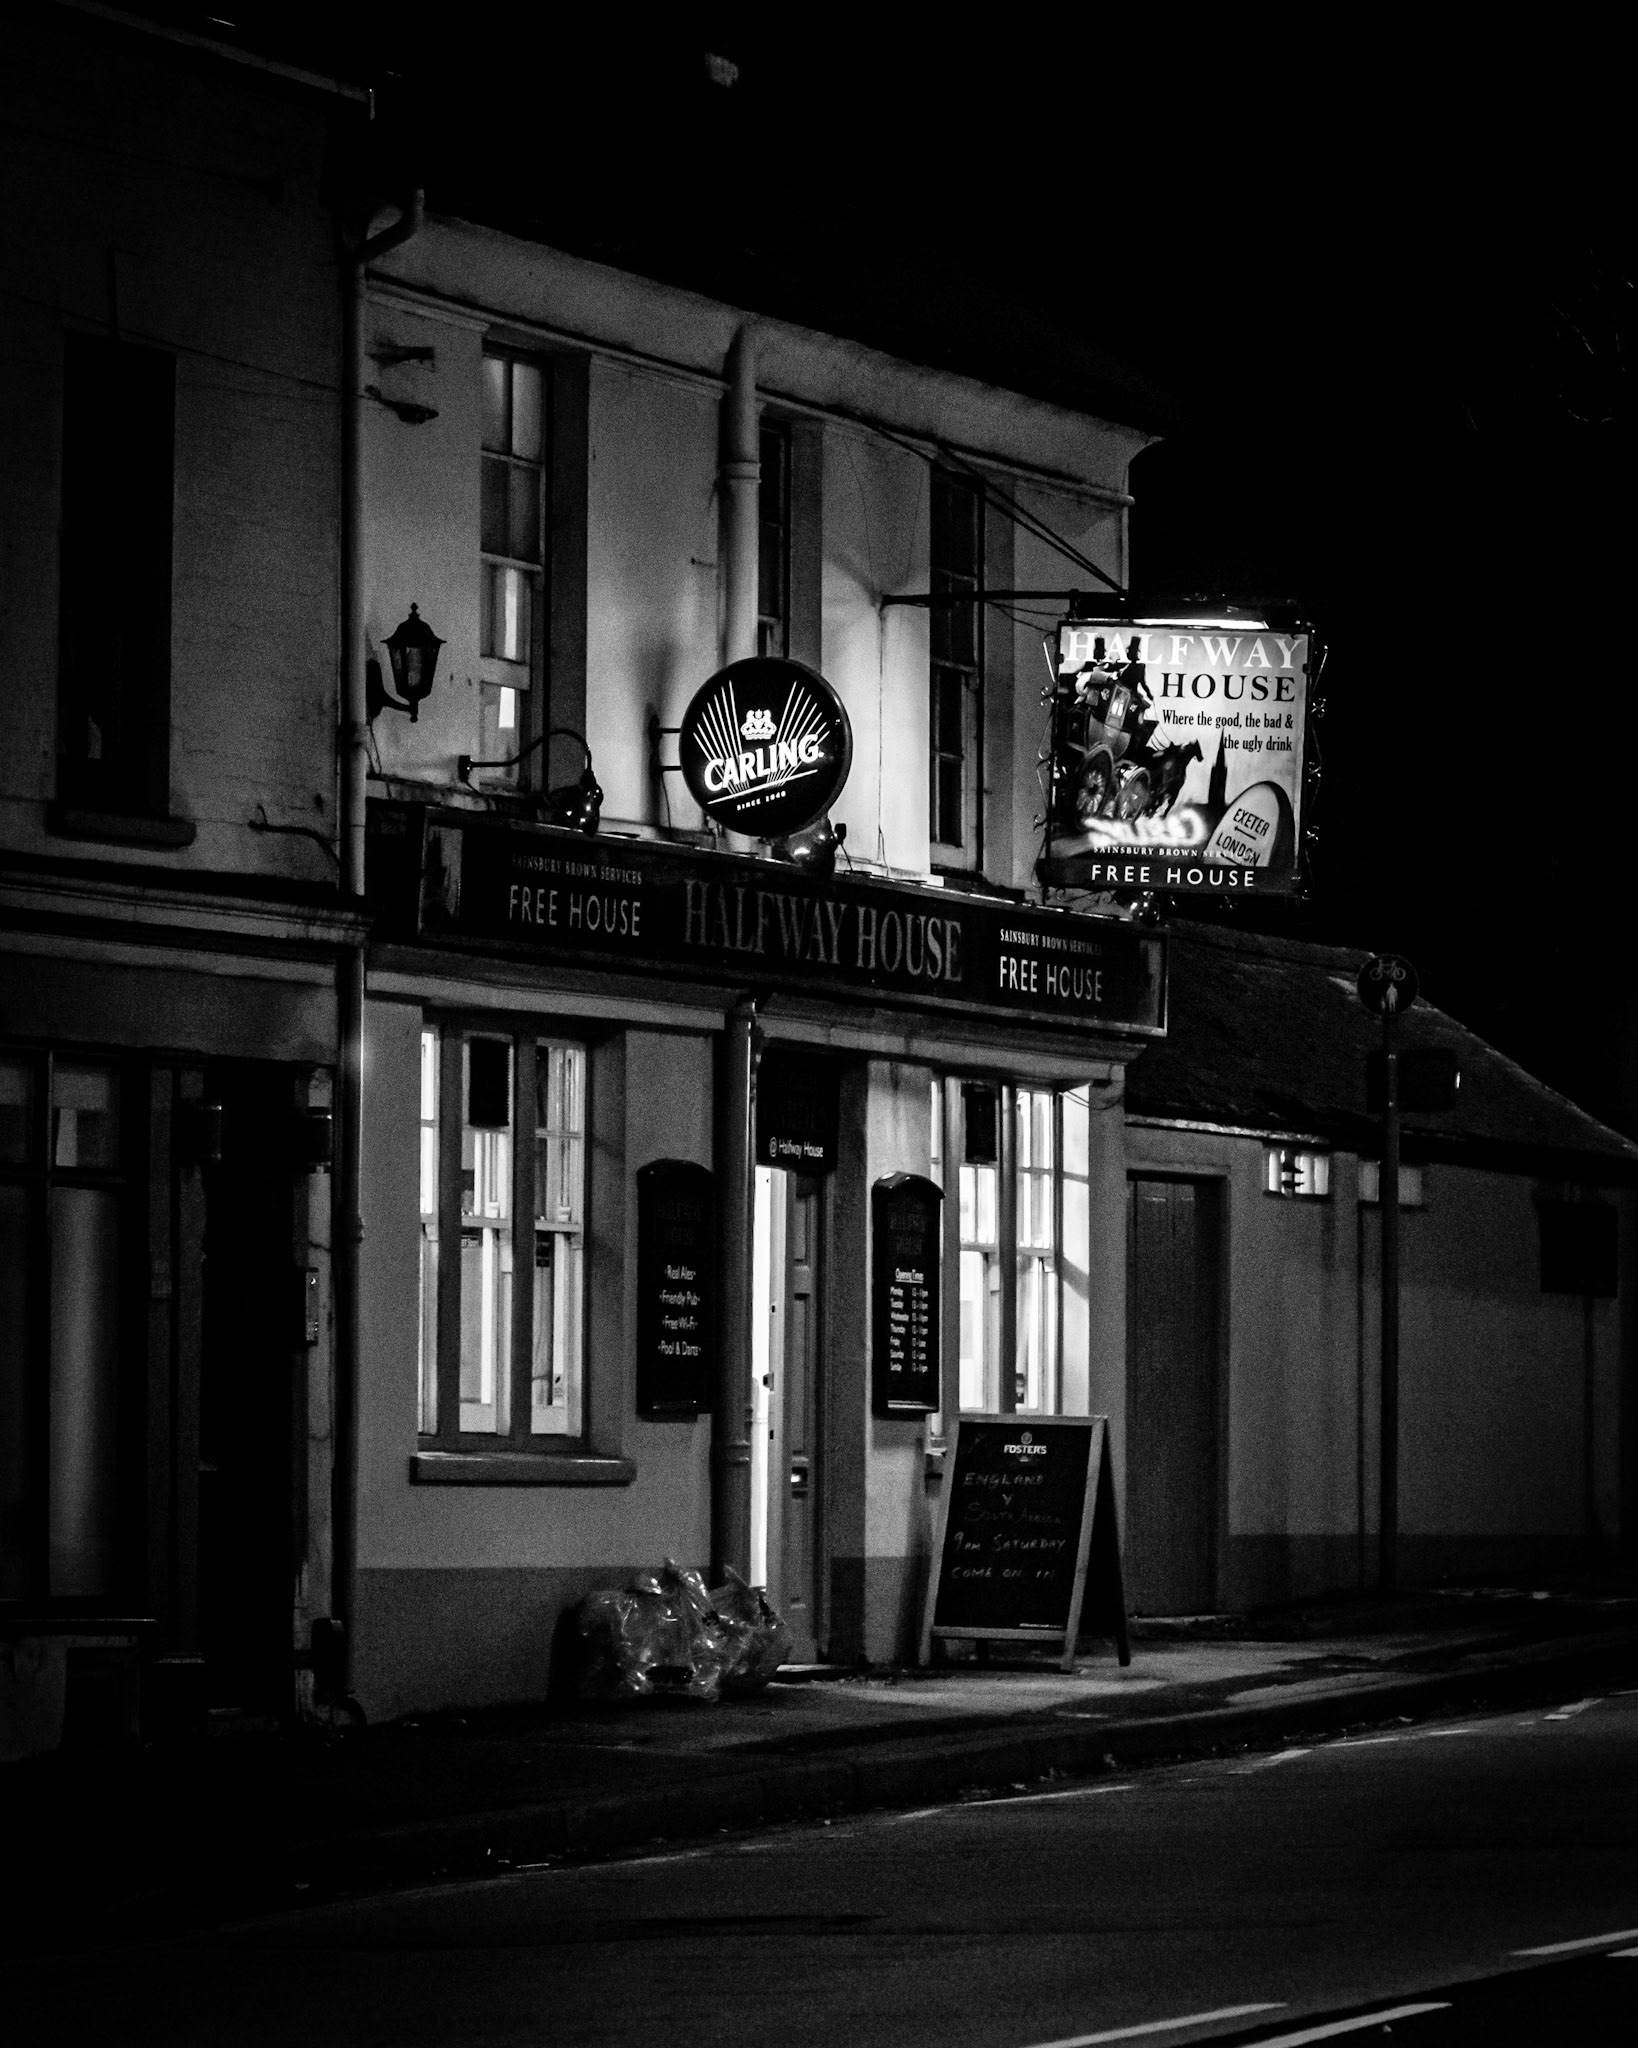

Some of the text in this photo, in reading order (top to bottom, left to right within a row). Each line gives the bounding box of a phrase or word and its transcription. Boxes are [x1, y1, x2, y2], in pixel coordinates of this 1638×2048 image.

[1065, 631, 1303, 669] HALFWAY
[1161, 672, 1296, 702] HOUSE
[1163, 709, 1294, 729] Where the good, the bad &
[1224, 735, 1293, 753] the ugly drink
[704, 733, 820, 792] CARLING
[736, 798, 761, 811] SINCE
[1232, 808, 1271, 838] EXETER
[1093, 846, 1155, 856] SAINSBURY
[1158, 847, 1198, 858] BROWN
[1215, 832, 1261, 867] LONDON
[565, 860, 597, 879] BROWN
[600, 865, 642, 885] SERVICES
[1091, 864, 1255, 887] FREE HOUSE
[509, 884, 641, 937] FREE HOUSE
[682, 878, 963, 982] HALFWAY HOUSE
[1000, 928, 1040, 947] SAINSBURY
[1042, 935, 1068, 952] BROWN
[1000, 955, 1102, 1003] FREE HOUSE
[769, 1136, 778, 1158] @
[803, 1141, 824, 1158] House
[963, 1471, 1045, 1488] ENGLAND
[951, 1566, 993, 1579] COME
[1002, 1567, 1023, 1579] ON
